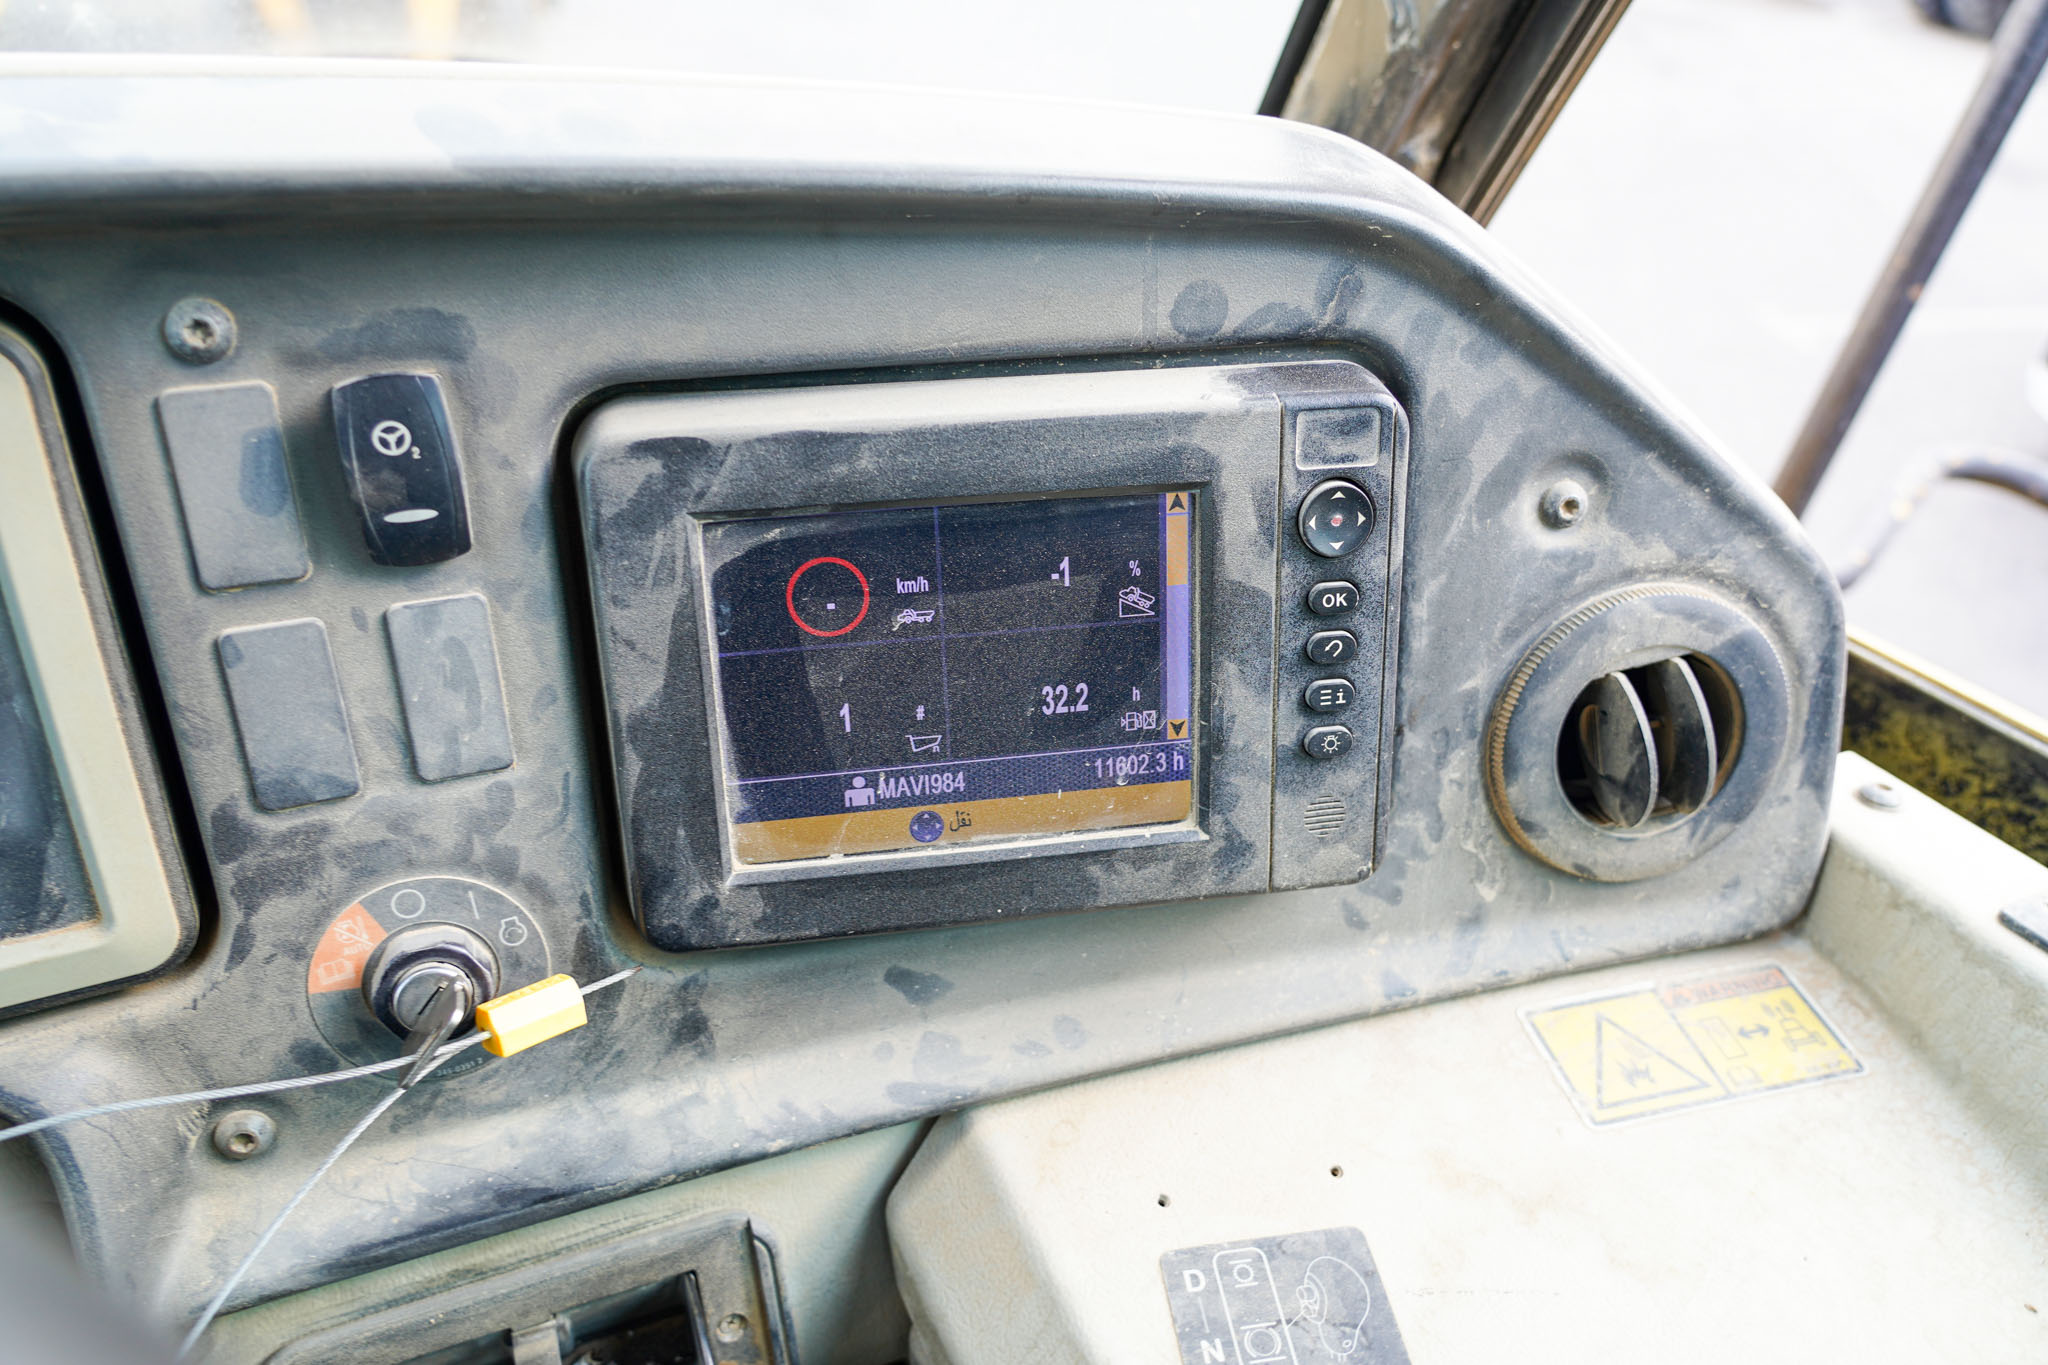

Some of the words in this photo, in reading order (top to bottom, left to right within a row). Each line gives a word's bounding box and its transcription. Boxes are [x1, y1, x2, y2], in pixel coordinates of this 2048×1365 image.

[411, 446, 422, 459] 2
[1051, 556, 1070, 587] -1
[1129, 560, 1141, 577] %
[896, 576, 929, 594] km/h
[1322, 592, 1348, 608] OK
[1041, 682, 1089, 716] 32.2
[1132, 686, 1141, 701] h
[840, 703, 851, 732] 1
[916, 705, 925, 720] #
[1095, 752, 1167, 778] 11602.3
[1173, 751, 1184, 770] h
[879, 771, 966, 799] MAVI984
[1182, 1269, 1207, 1293] D
[1200, 1338, 1226, 1365] N
